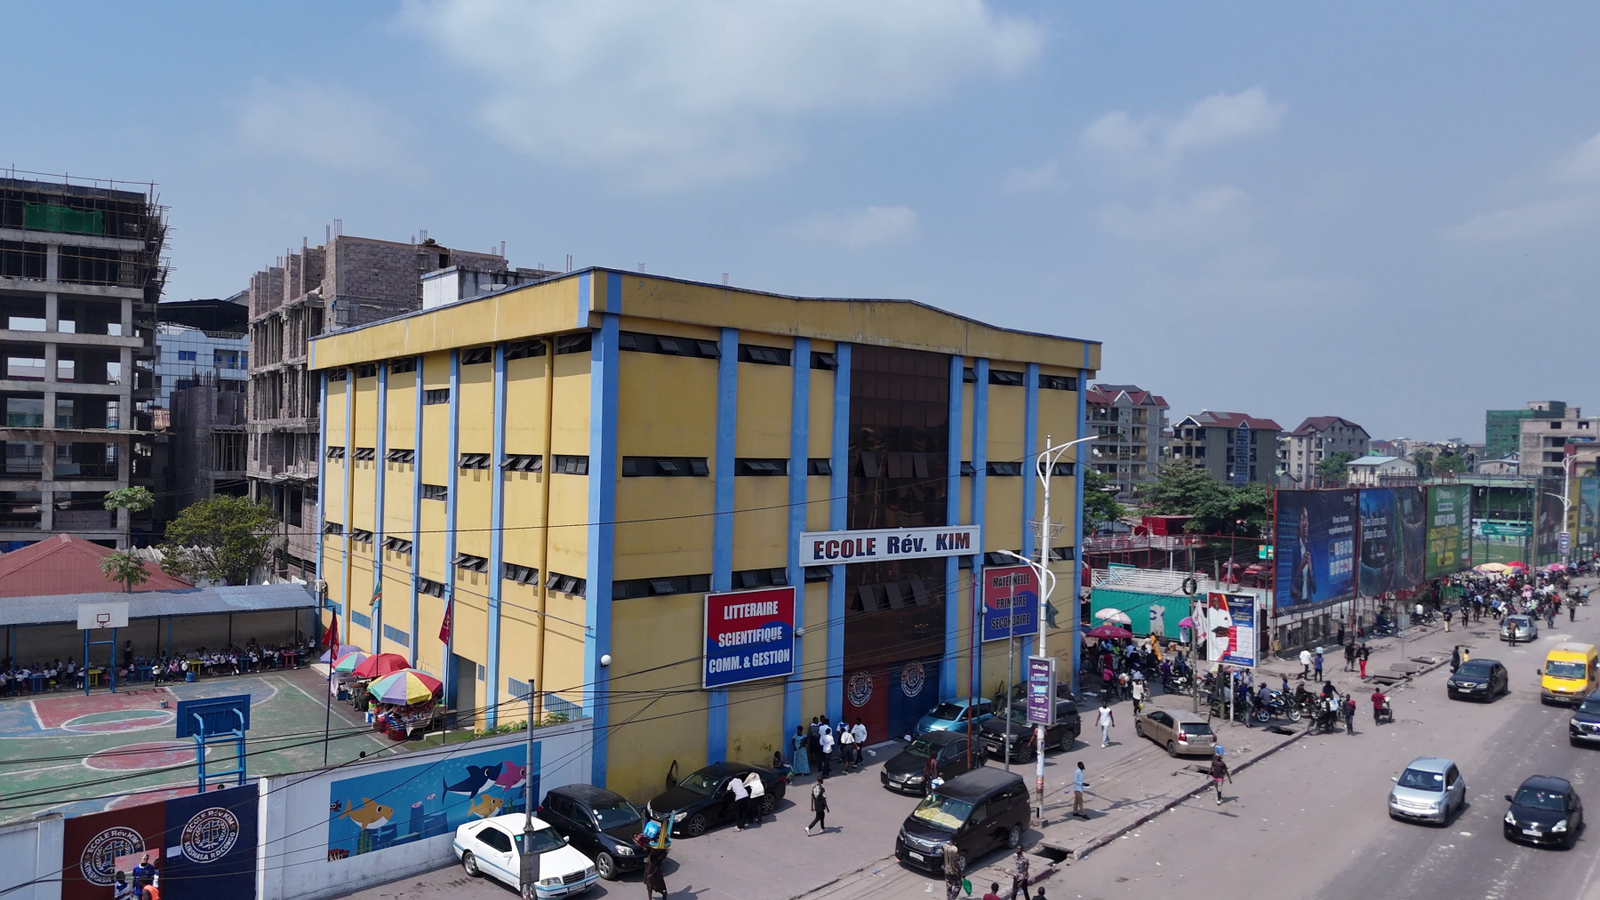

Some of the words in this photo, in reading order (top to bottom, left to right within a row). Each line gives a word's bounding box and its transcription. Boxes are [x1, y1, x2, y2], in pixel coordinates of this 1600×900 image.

[813, 537, 876, 560] ECOLE
[887, 533, 927, 554] Rév.
[935, 532, 970, 551] KIM
[723, 600, 778, 620] LITTERAIRE
[995, 595, 1026, 610] PRIMAIRE
[718, 626, 783, 648] SCIENTIFIQUE
[708, 655, 742, 674] COMM.
[743, 656, 750, 669] &
[752, 648, 790, 667] GESTION
[186, 813, 207, 833] ECOLE
[87, 832, 110, 853] ECOLE
[184, 841, 209, 860] KINSHASA
